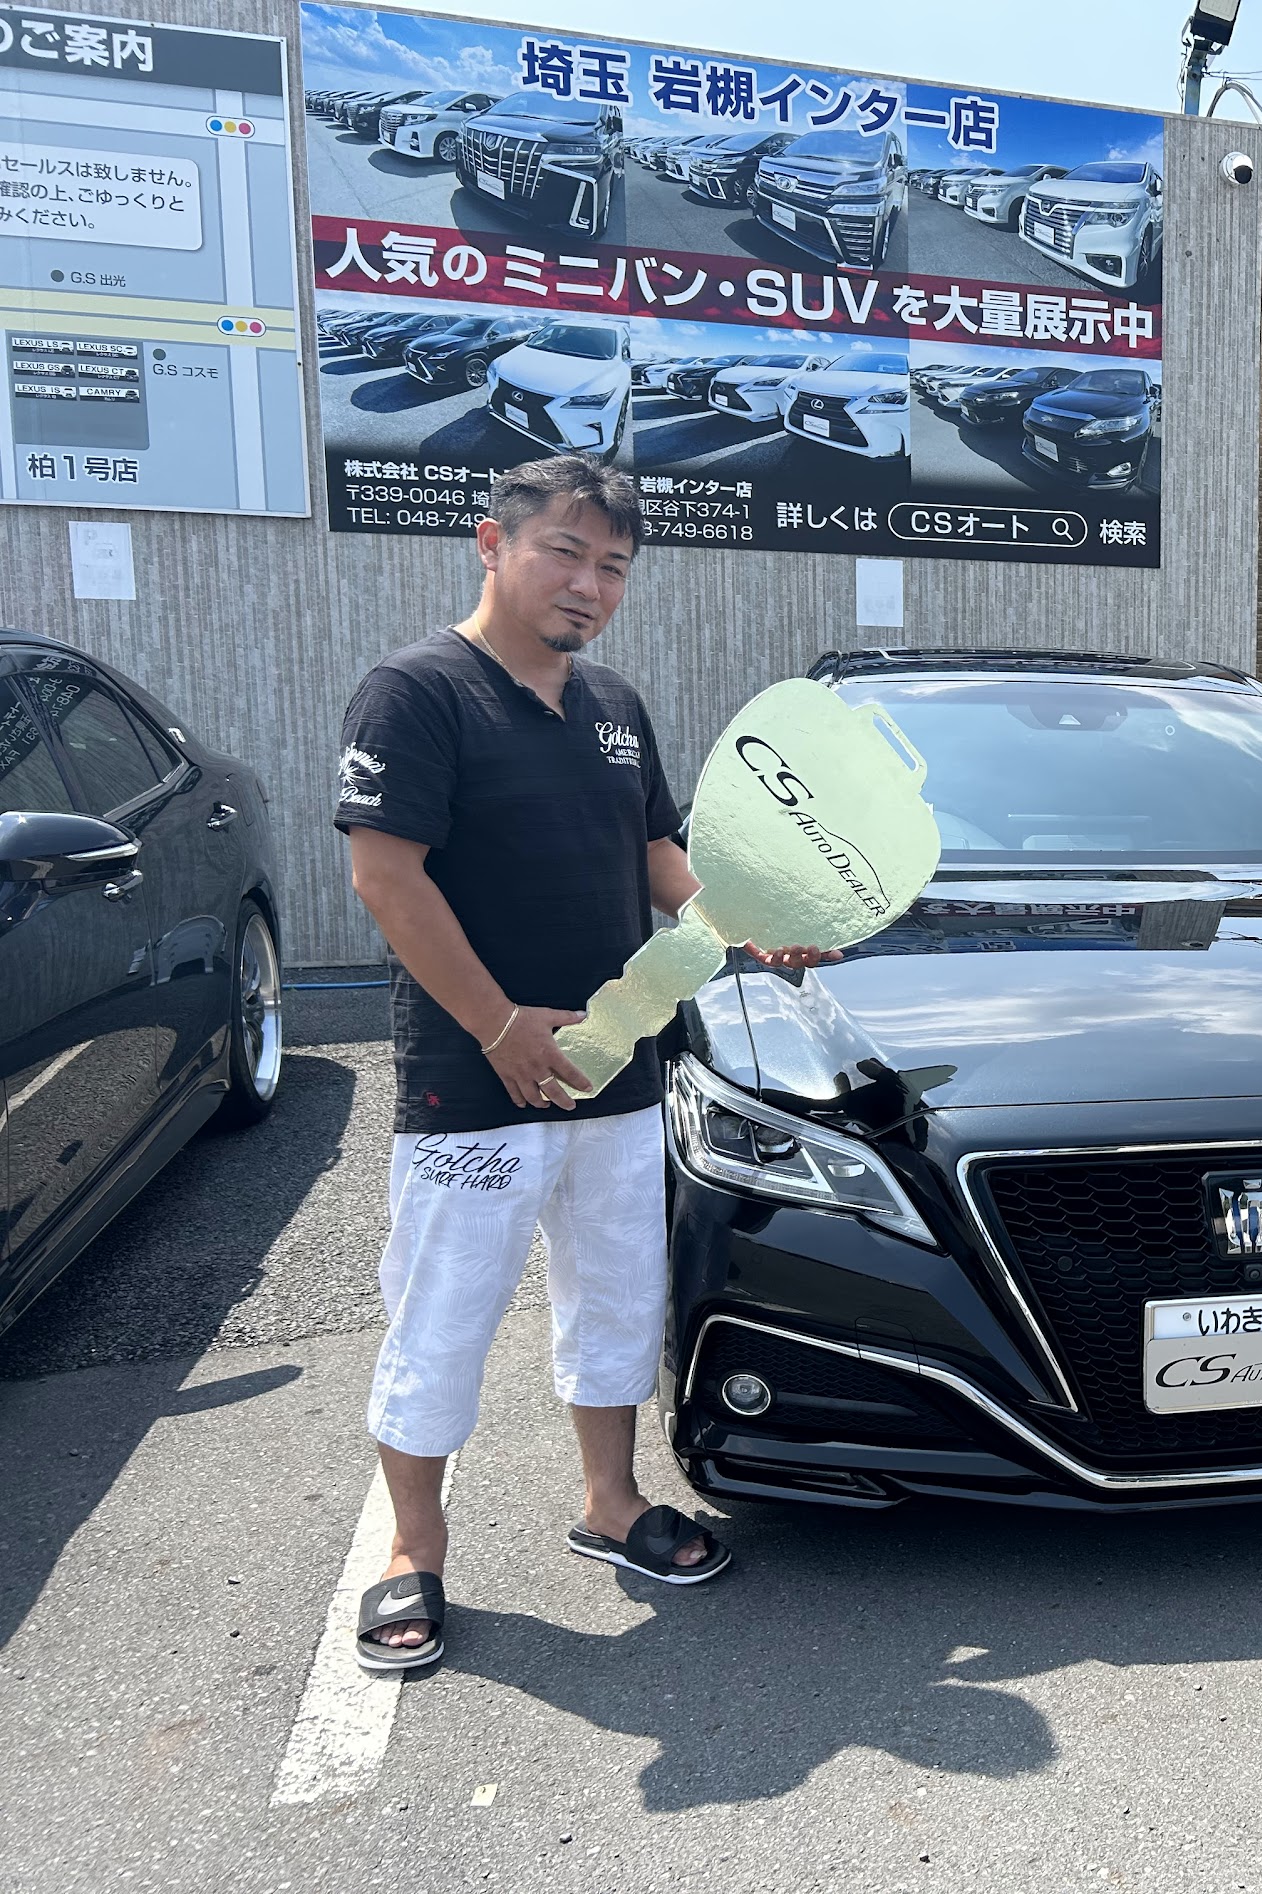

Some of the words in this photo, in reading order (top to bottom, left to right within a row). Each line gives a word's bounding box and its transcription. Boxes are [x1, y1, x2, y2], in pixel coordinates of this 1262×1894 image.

[521, 40, 631, 105] 埼玉
[652, 57, 998, 151] 岩槻インター店
[0, 155, 192, 188] セールスは致しません。
[70, 271, 96, 285] G.S
[100, 274, 126, 288] 出光
[325, 227, 488, 288] 人気の
[892, 284, 1154, 350] を大量展示中
[14, 339, 44, 347] LEXUS
[78, 343, 108, 352] LEXUS
[15, 362, 45, 370] LEXUS
[80, 365, 110, 373] LEXUS
[111, 367, 124, 375] CT
[152, 364, 178, 377] G.S
[182, 366, 219, 379] コスモ
[17, 385, 47, 393] LEXUS
[86, 388, 121, 396] CAMRY
[27, 453, 139, 484] 柏1号店
[344, 459, 419, 481] 株式会社
[424, 464, 510, 485] CSオート
[640, 476, 753, 498] 岩槻インター店
[346, 507, 391, 525] TEL:
[776, 501, 878, 531] 詳しくは
[910, 510, 1030, 539] CSオート
[1099, 519, 1147, 546] 検索
[595, 721, 640, 754] Gotcha
[735, 735, 815, 807] CS
[339, 786, 383, 807] Beach
[412, 1132, 524, 1175] Gotcha
[421, 1166, 463, 1188] SURF
[461, 1174, 512, 1191] HARD
[1155, 1353, 1237, 1388] CS
